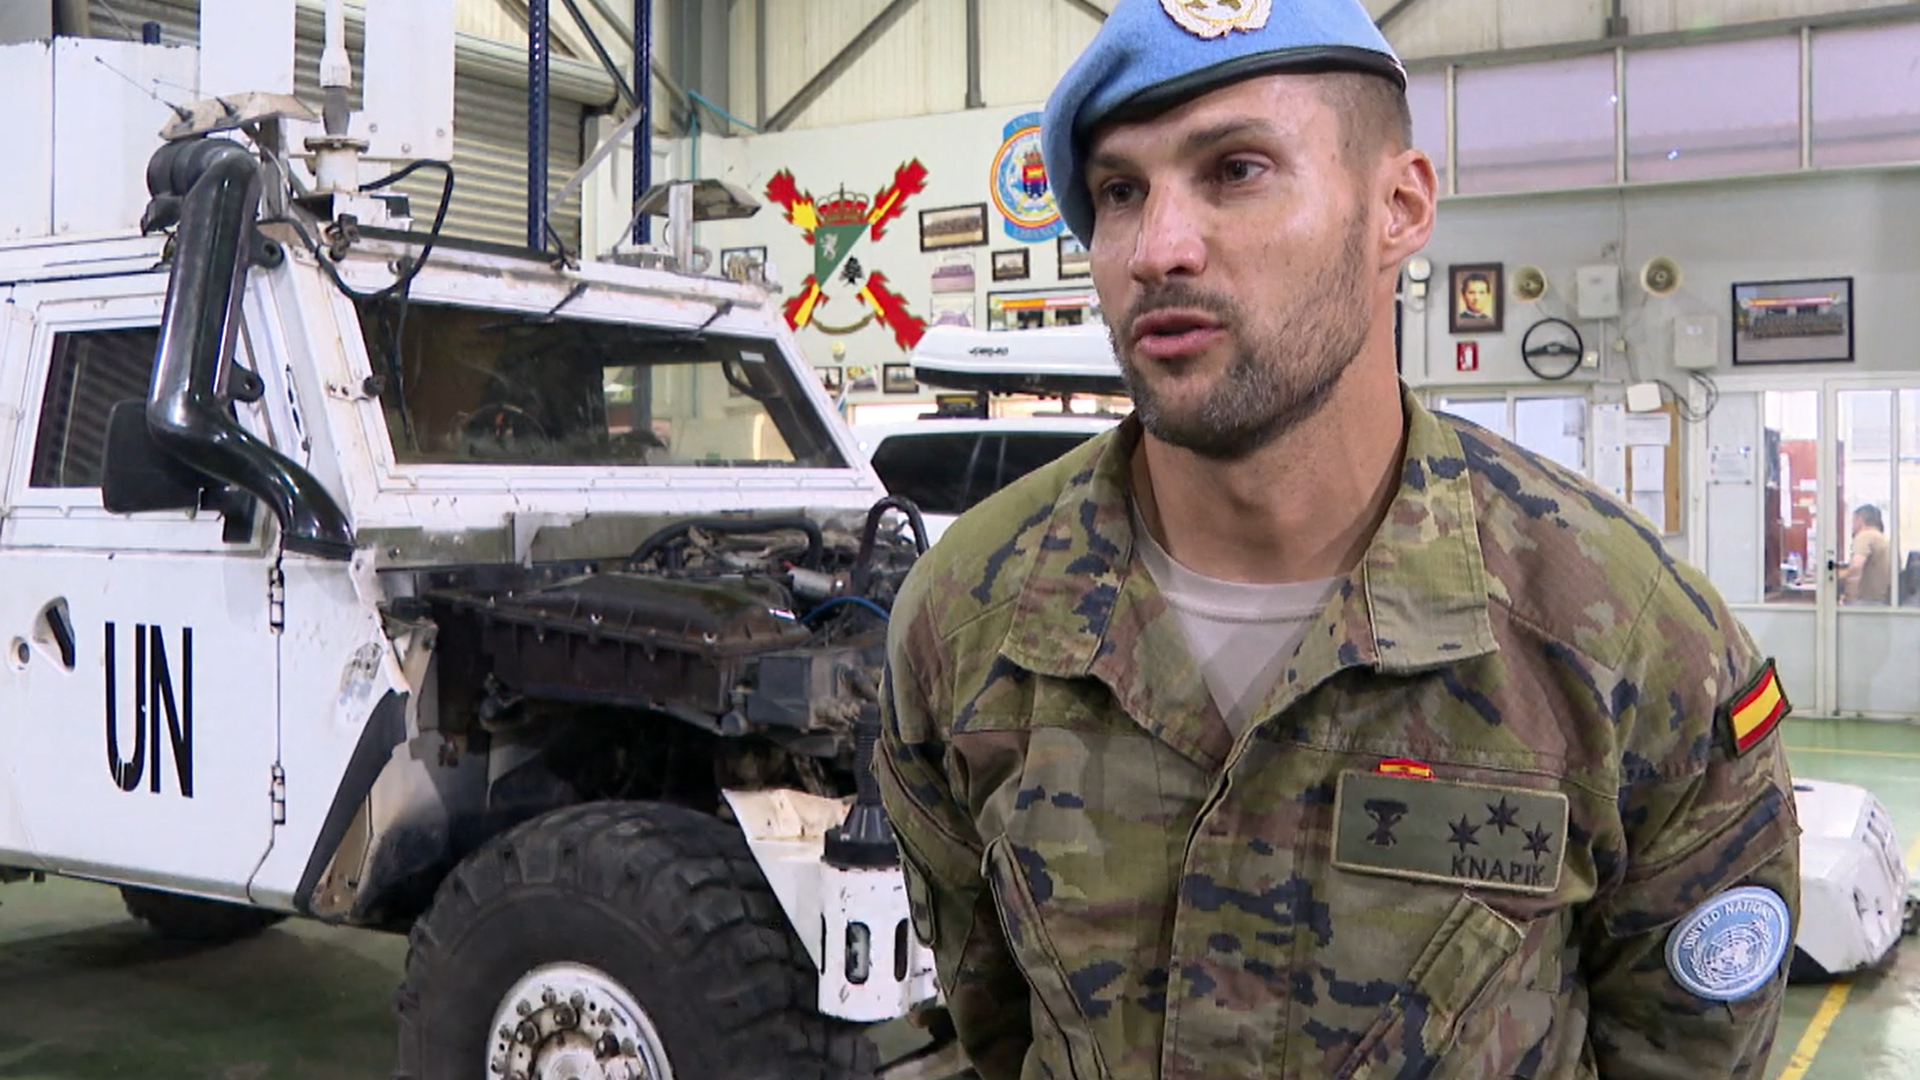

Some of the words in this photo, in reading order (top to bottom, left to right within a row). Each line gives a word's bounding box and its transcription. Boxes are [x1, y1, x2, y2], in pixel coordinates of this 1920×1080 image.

[105, 621, 193, 798] UN
[1451, 855, 1546, 887] KNAPIK
[1682, 910, 1721, 950] UNITED
[1724, 899, 1774, 921] NATIONS
